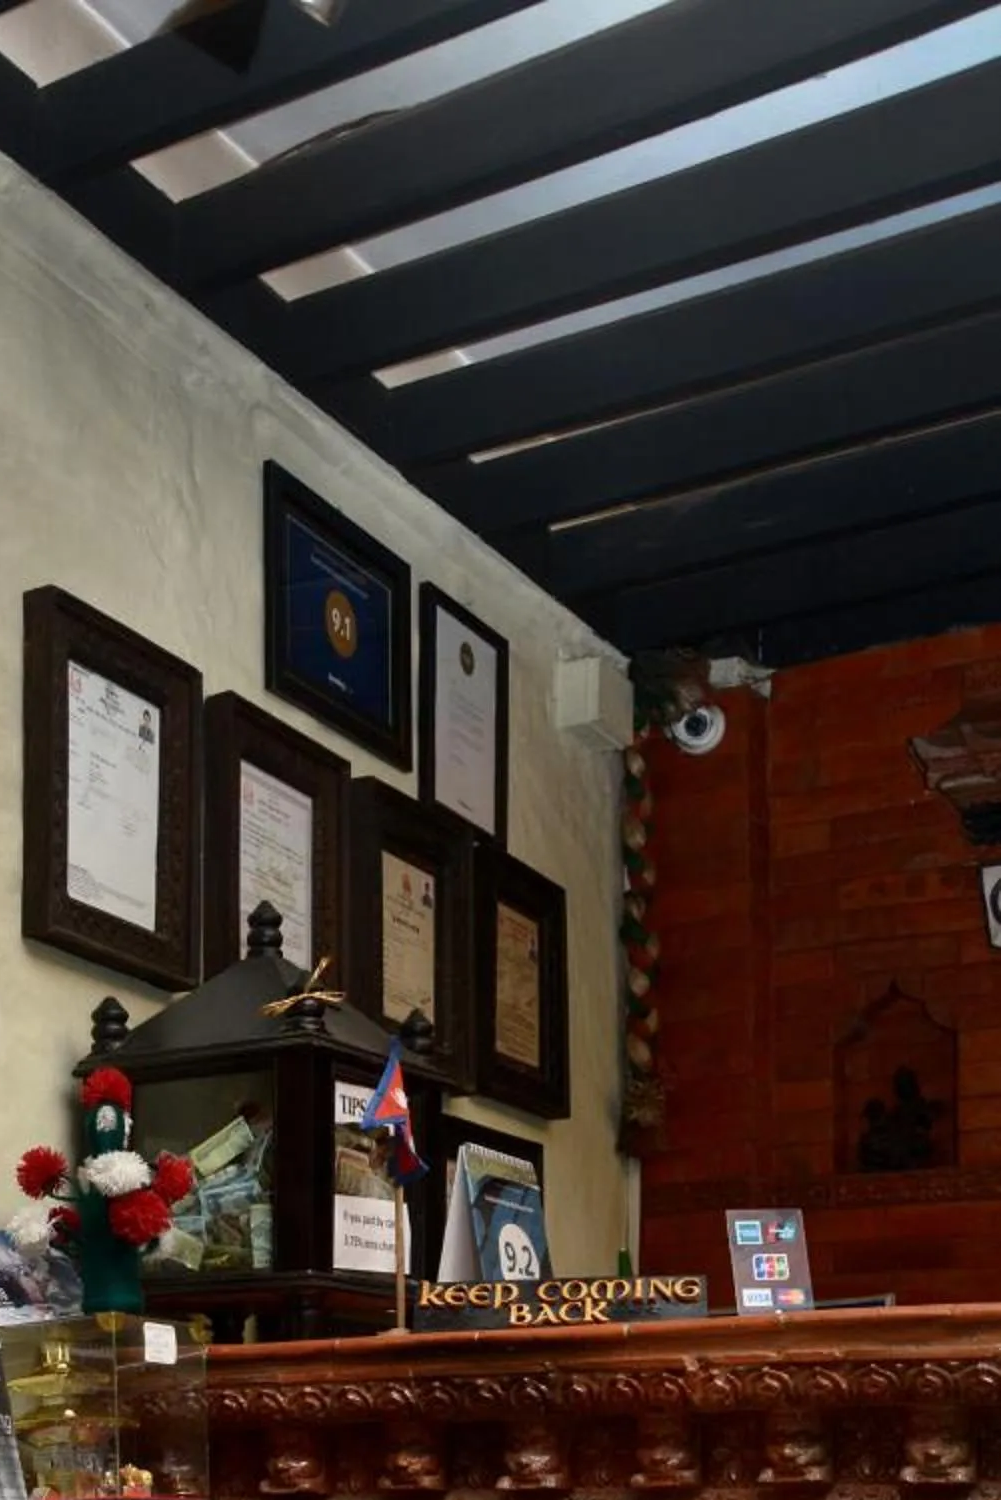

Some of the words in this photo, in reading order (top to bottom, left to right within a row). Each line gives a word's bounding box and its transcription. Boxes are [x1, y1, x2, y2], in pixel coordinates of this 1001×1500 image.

[332, 608, 351, 641] 9.1
[340, 1094, 368, 1118] TIPS
[504, 1241, 536, 1277] 9.2
[419, 1281, 519, 1309] KEEP
[536, 1278, 700, 1303] COMING
[508, 1298, 611, 1325] BACK
